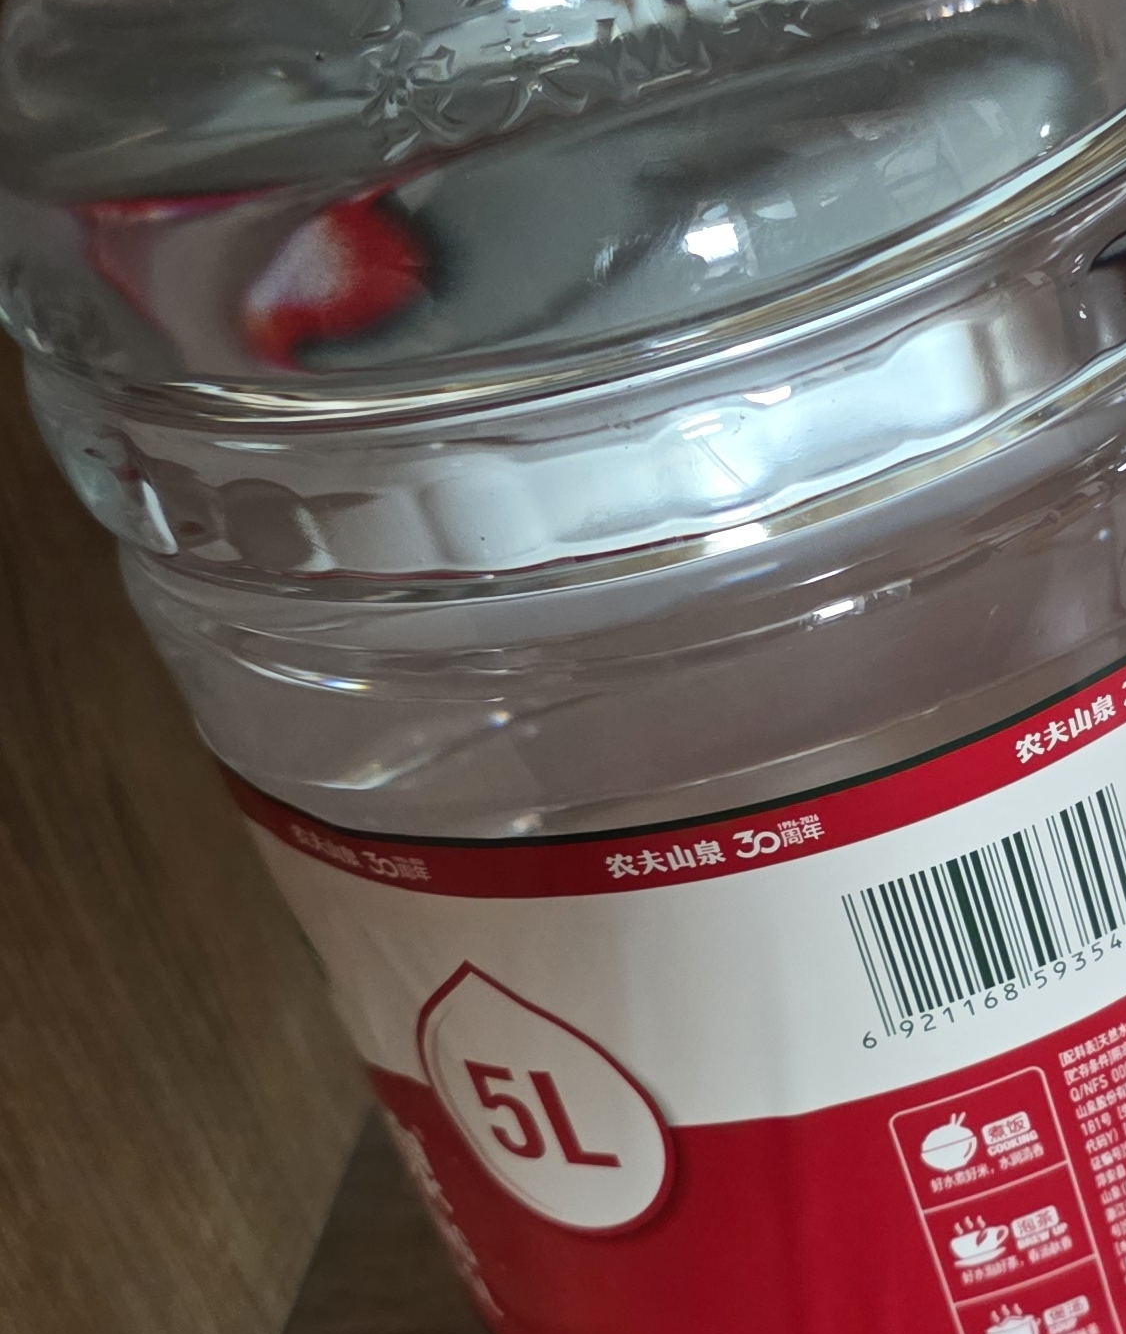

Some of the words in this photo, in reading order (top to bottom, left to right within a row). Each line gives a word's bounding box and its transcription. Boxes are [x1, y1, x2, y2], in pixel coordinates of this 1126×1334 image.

[1015, 694, 1117, 764] 农夫山泉
[605, 839, 727, 879] 农夫山泉
[1069, 1074, 1109, 1103] Q/NFS
[464, 1059, 622, 1167] 5L
[987, 1114, 1027, 1143] 煮饭
[987, 1129, 1039, 1157] COOKING
